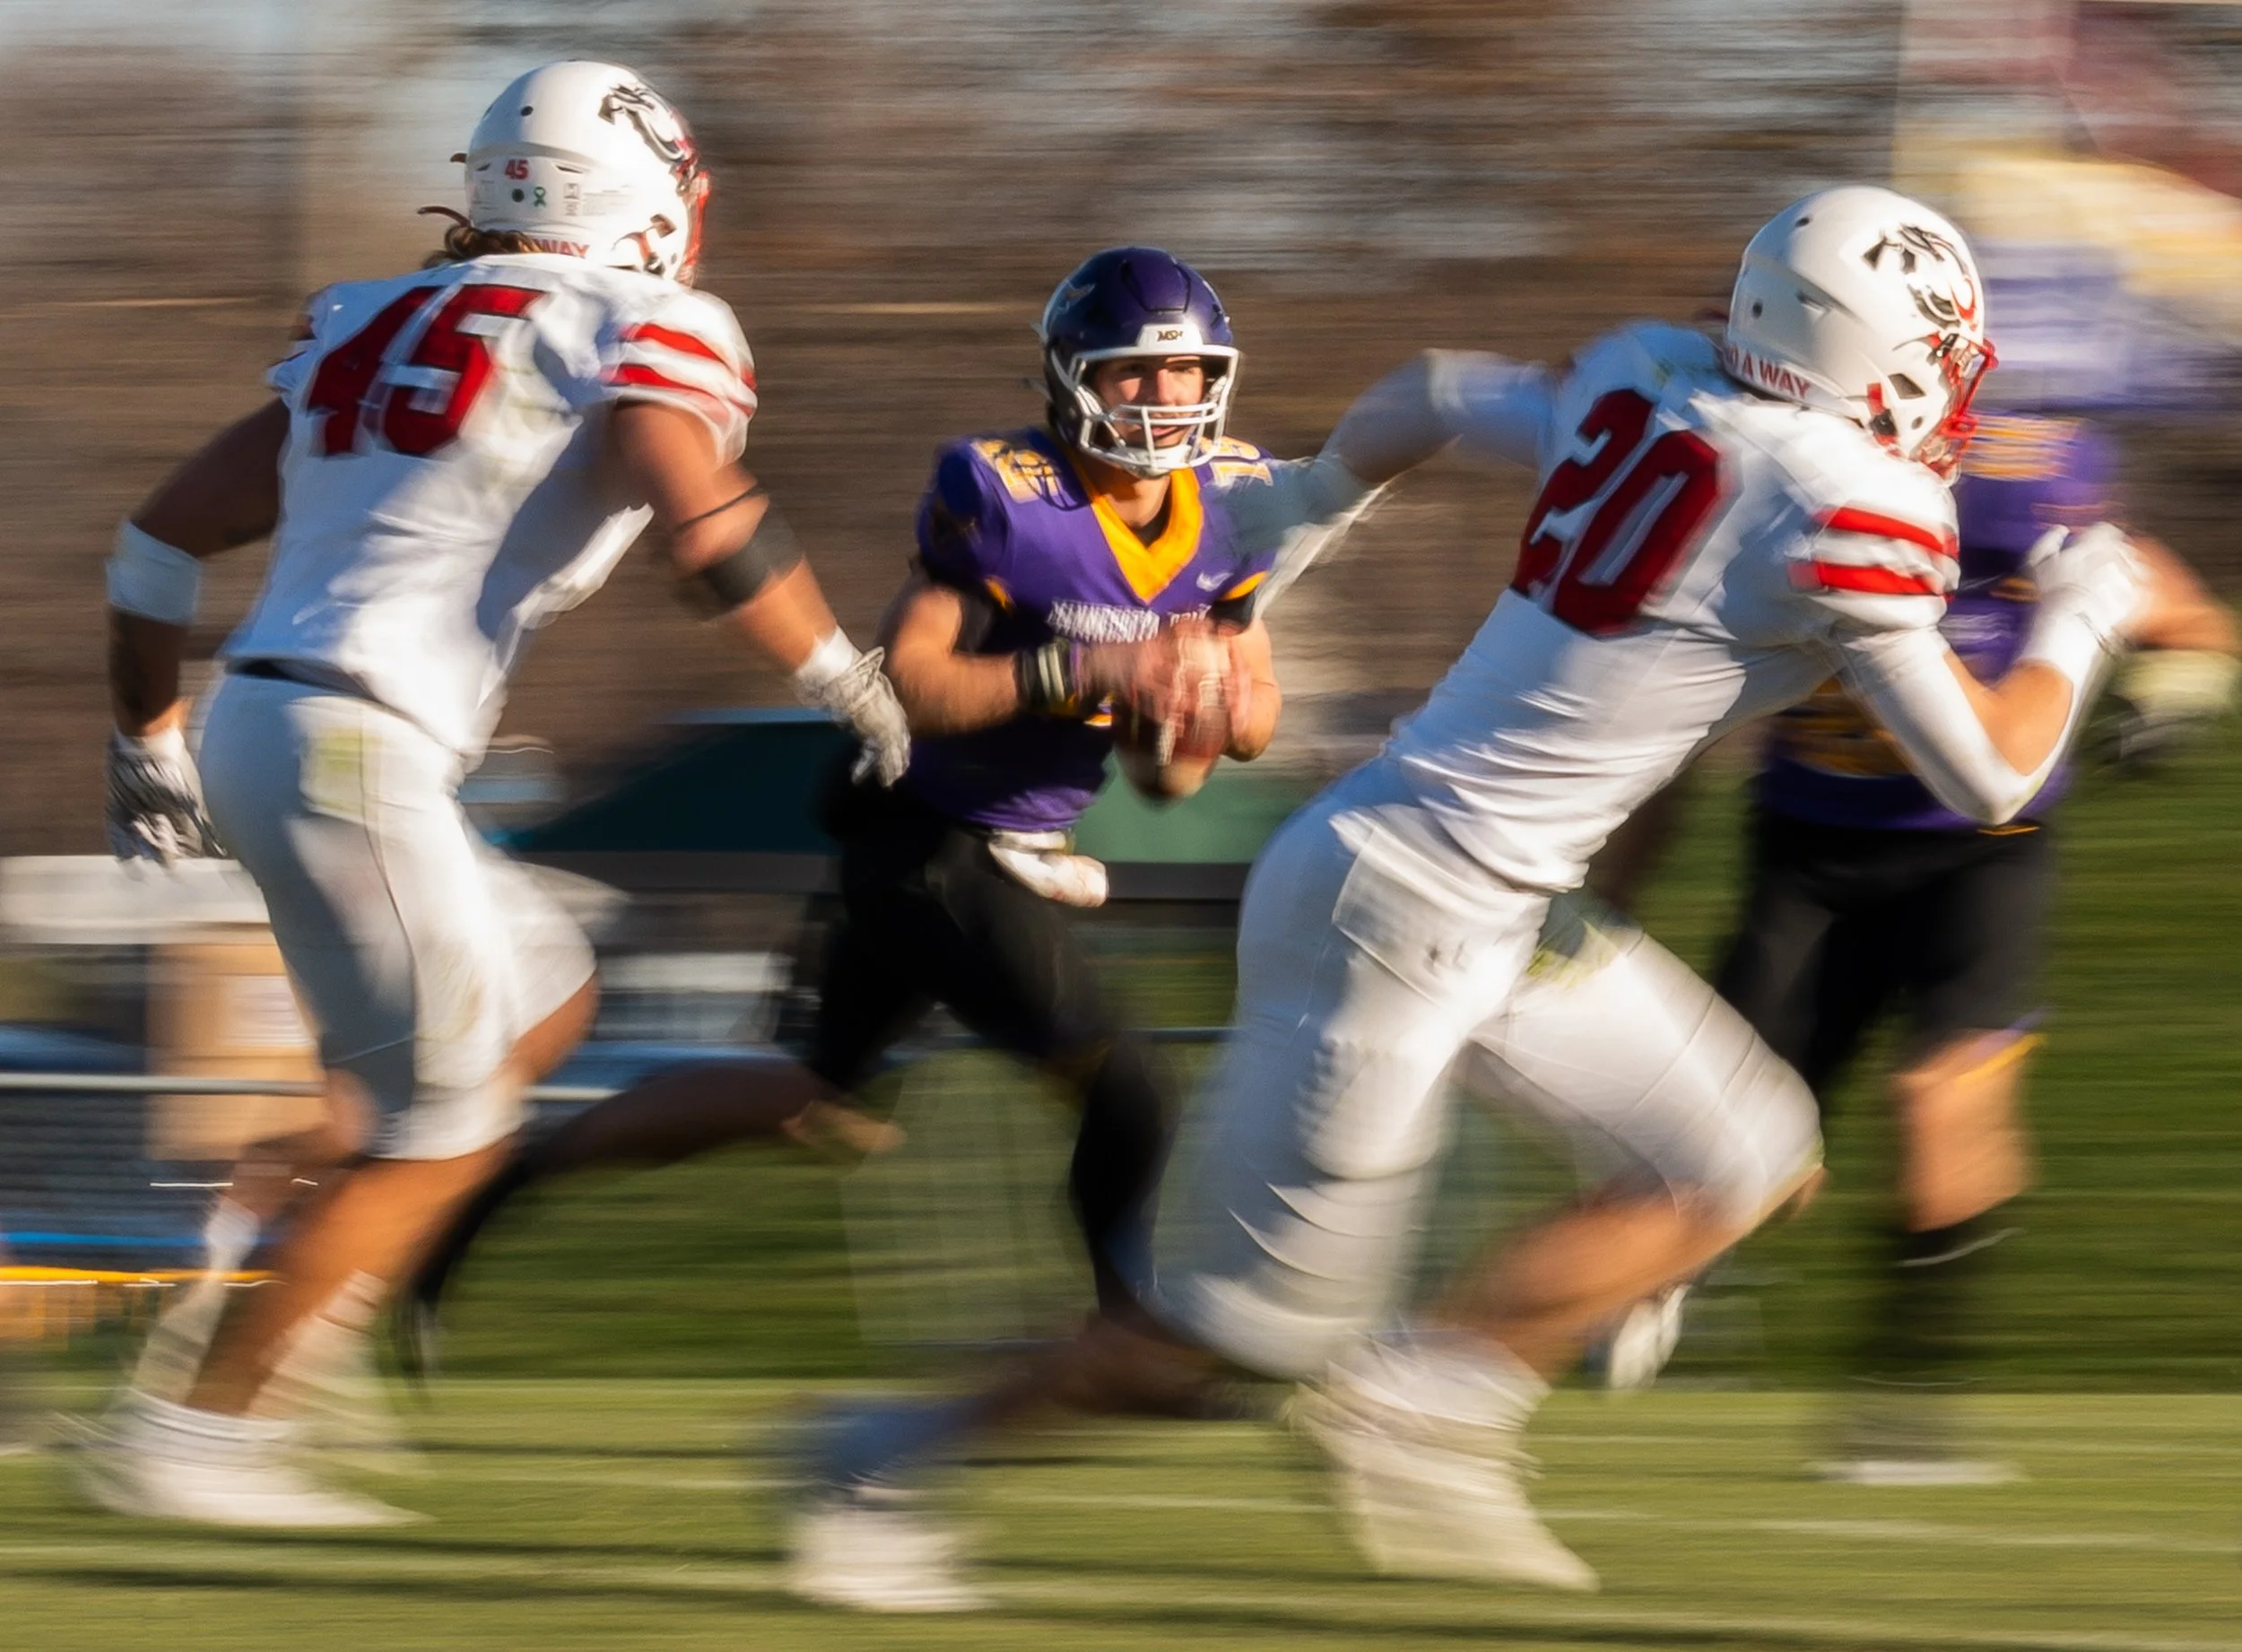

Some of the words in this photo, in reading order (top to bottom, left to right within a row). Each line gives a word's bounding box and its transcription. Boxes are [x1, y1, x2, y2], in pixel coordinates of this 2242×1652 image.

[503, 159, 529, 180] 45
[307, 284, 548, 457] 45
[1759, 357, 1811, 400] WAY
[1510, 387, 1722, 641] 20
